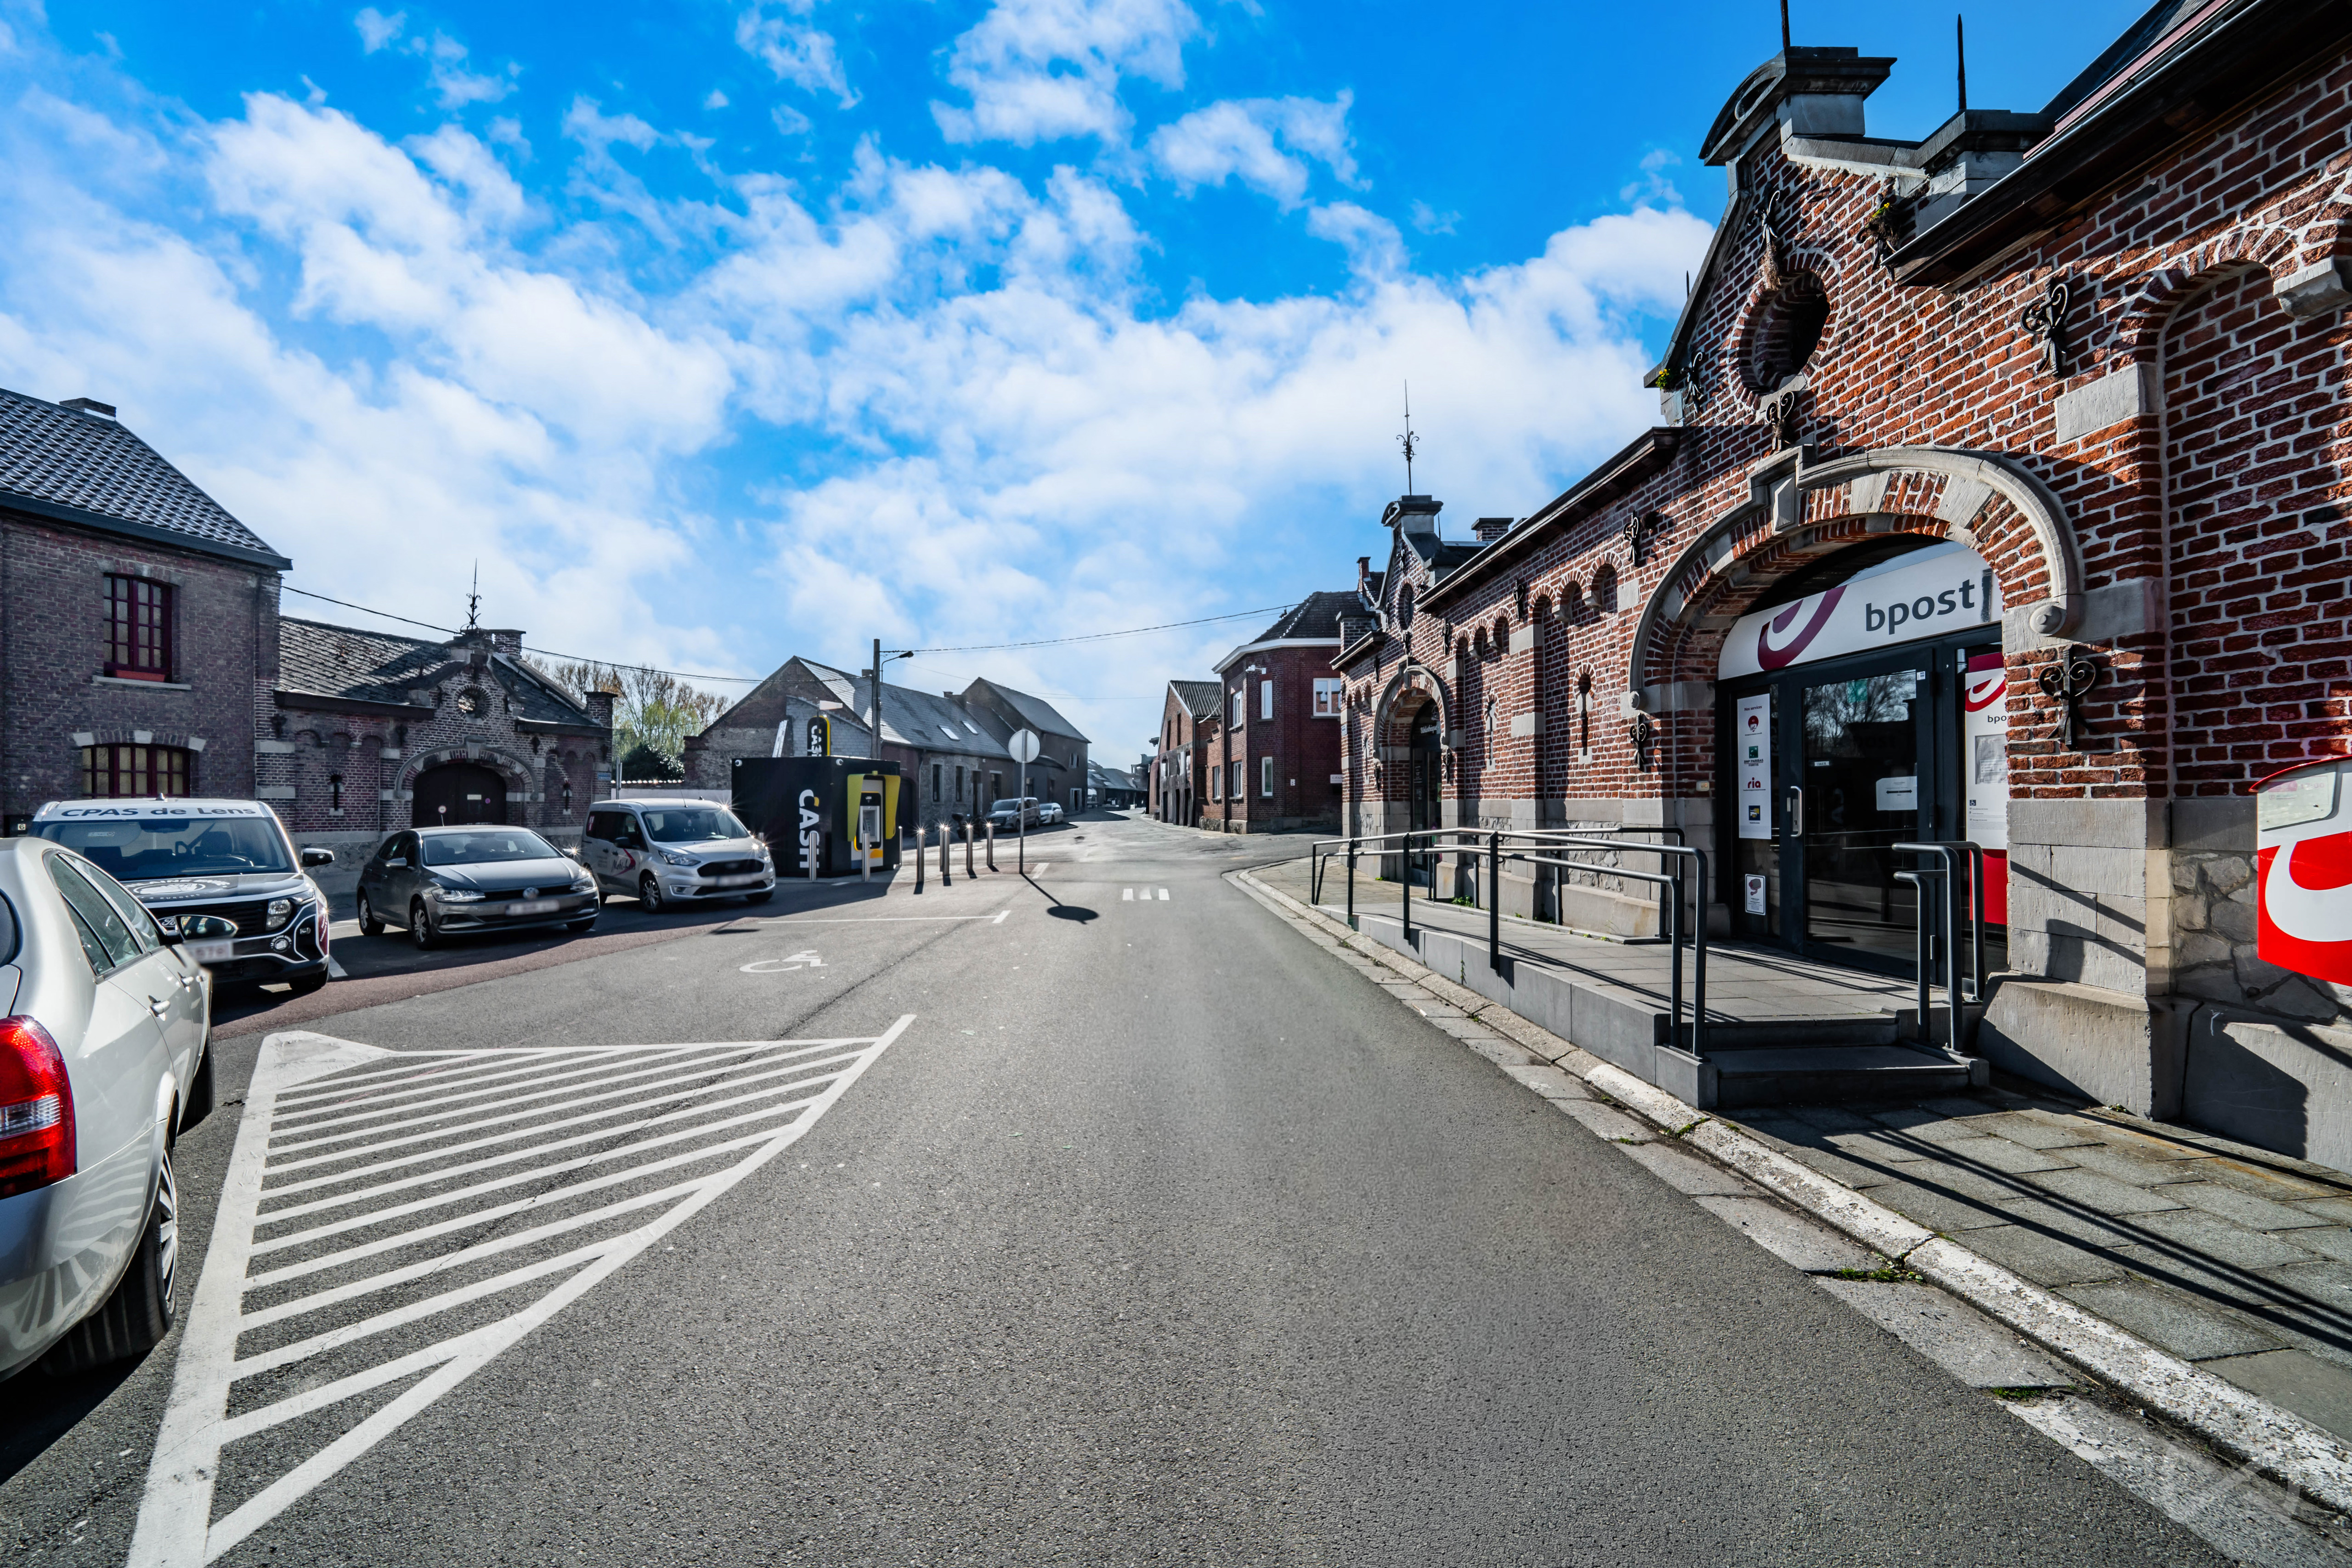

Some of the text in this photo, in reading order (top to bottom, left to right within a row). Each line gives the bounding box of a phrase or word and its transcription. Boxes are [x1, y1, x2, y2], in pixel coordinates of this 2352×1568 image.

[1866, 579, 1975, 635] bpost
[1988, 715, 2007, 724] bpo
[811, 725, 822, 756] CAS
[1747, 777, 1761, 788] ria
[61, 808, 139, 817] CPAS
[799, 789, 820, 869] CASH
